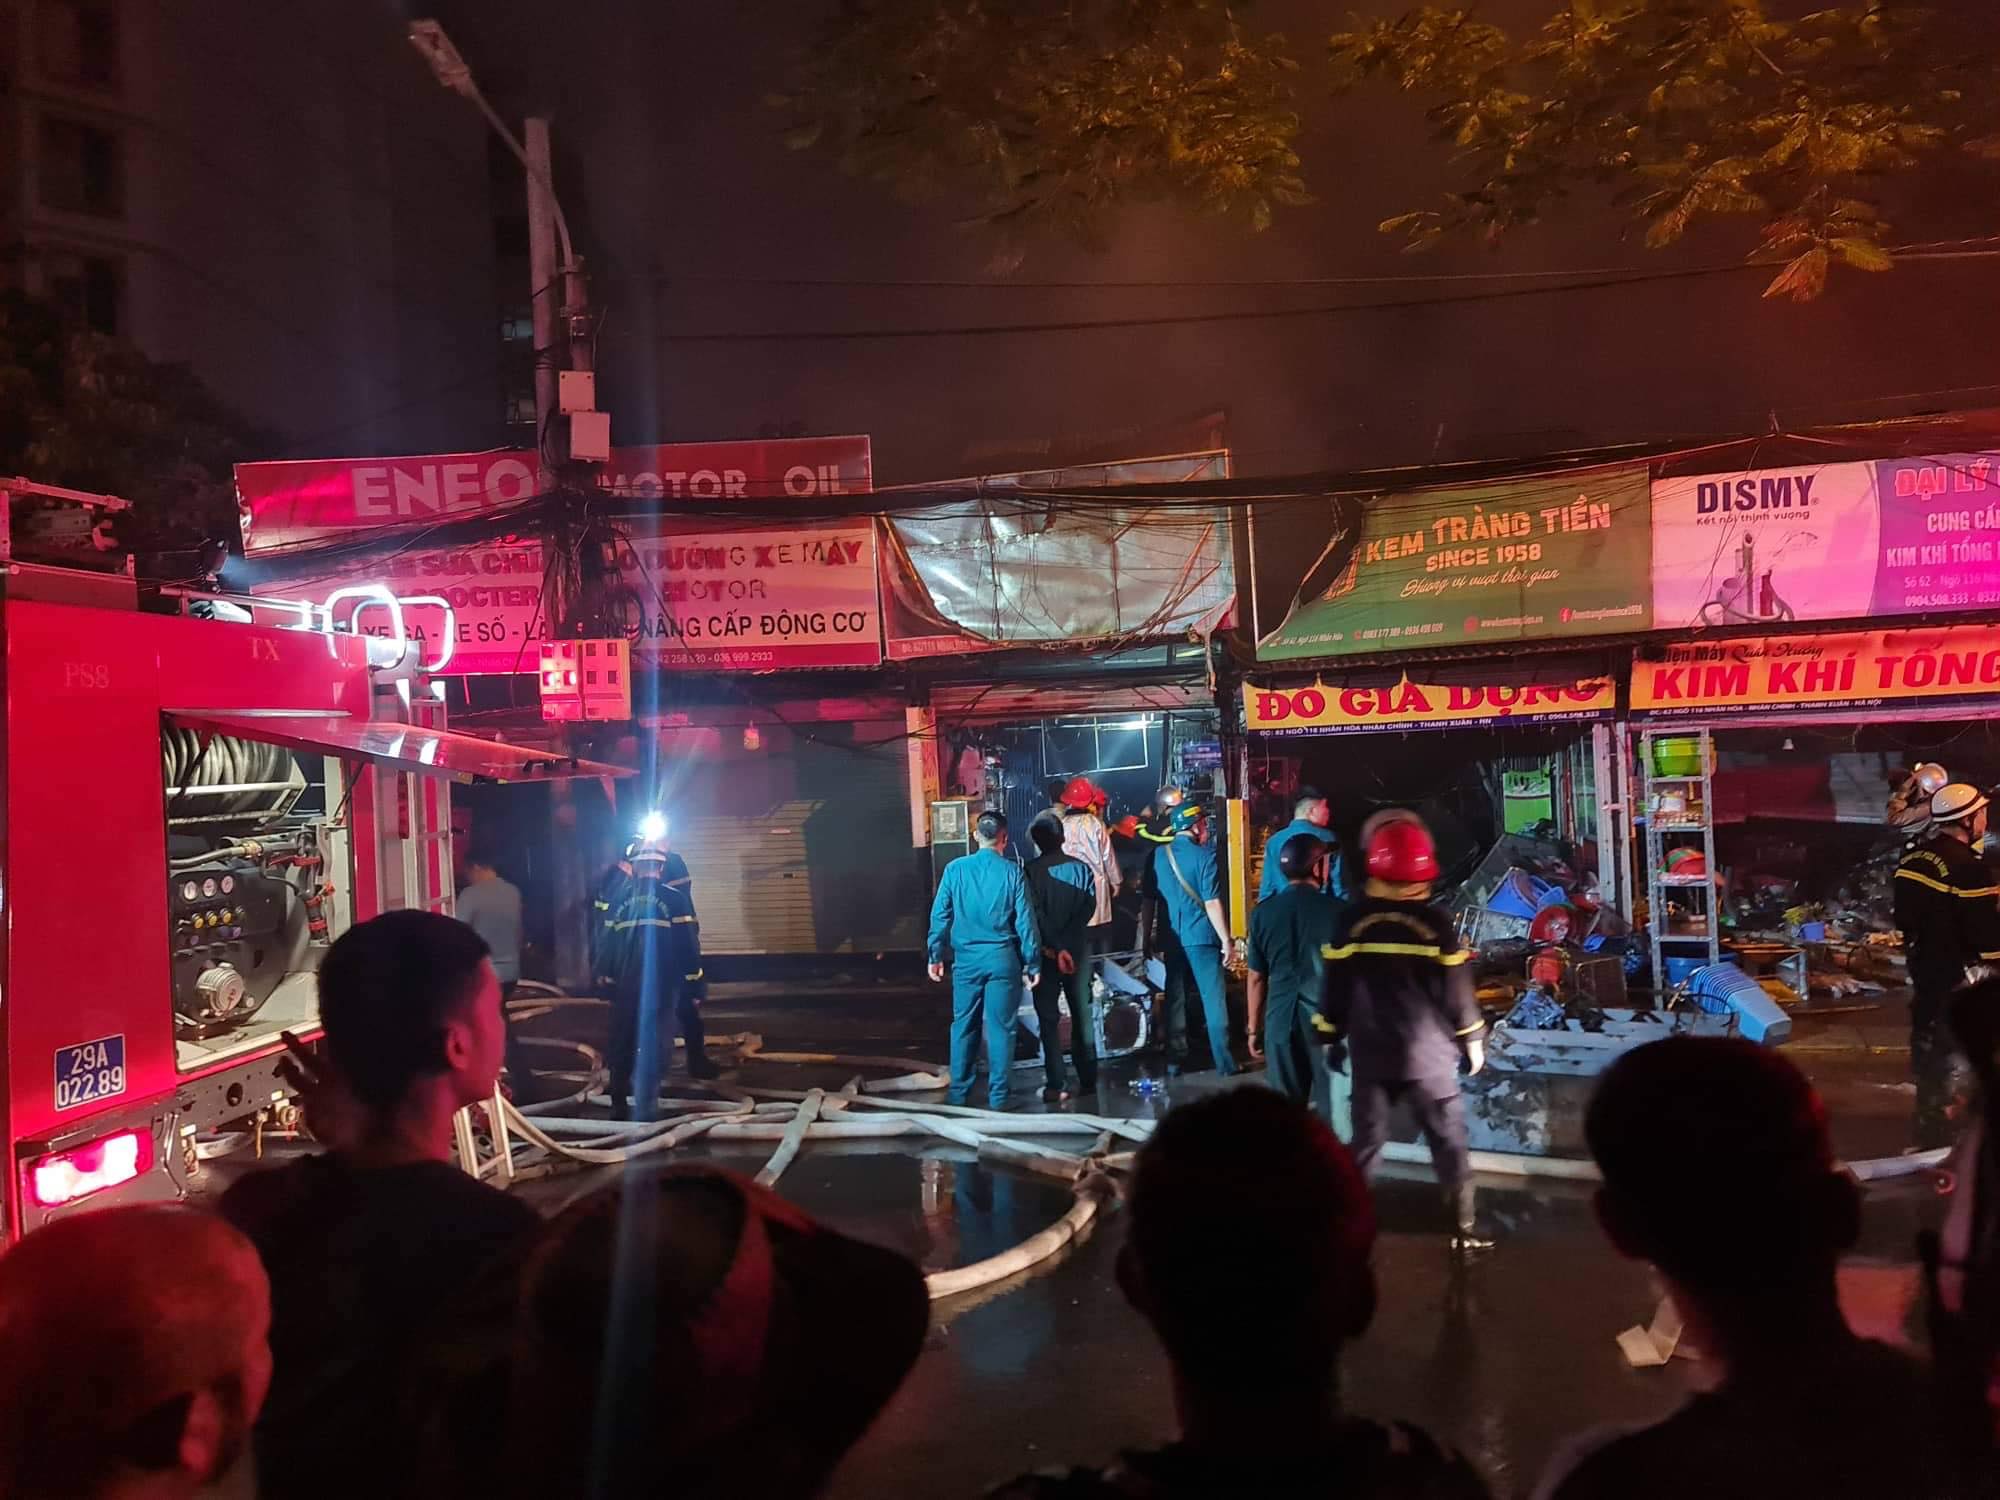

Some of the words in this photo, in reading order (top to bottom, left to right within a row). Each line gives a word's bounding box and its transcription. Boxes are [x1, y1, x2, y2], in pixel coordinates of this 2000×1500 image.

[352, 459, 541, 517] ENEO
[597, 470, 748, 499] MOTOR
[783, 464, 849, 498] OIL
[1697, 475, 1815, 514] DISMY
[1895, 466, 1947, 501] ĐẠI
[1365, 530, 1424, 565] KEM
[1432, 504, 1531, 545] TRÀNG
[1696, 515, 1715, 526] Kết
[1741, 511, 1770, 523] thịnh
[1927, 511, 1970, 533] CUNG
[1975, 502, 2000, 530] CẤ
[753, 544, 793, 568] XE
[1425, 548, 1490, 573] SINCE
[1496, 543, 1542, 564] 1958
[1886, 547, 1917, 568] KIM
[1921, 540, 1947, 566] KHÍ
[477, 614, 506, 642] SỐ
[640, 611, 701, 639] NÂNG
[708, 607, 751, 637] CẤP
[760, 608, 826, 641] ĐỘNG
[833, 611, 867, 633] CƠ
[249, 636, 281, 662] TX
[1665, 647, 1691, 668] iện
[1653, 664, 1750, 700] KIM
[1767, 652, 1855, 695] KHÍ
[1339, 682, 1434, 716] GIA
[1420, 720, 1448, 729] THANH
[1450, 717, 1473, 727] XUÂN
[71, 1042, 109, 1076] 29A
[57, 1065, 123, 1107] 022.89
